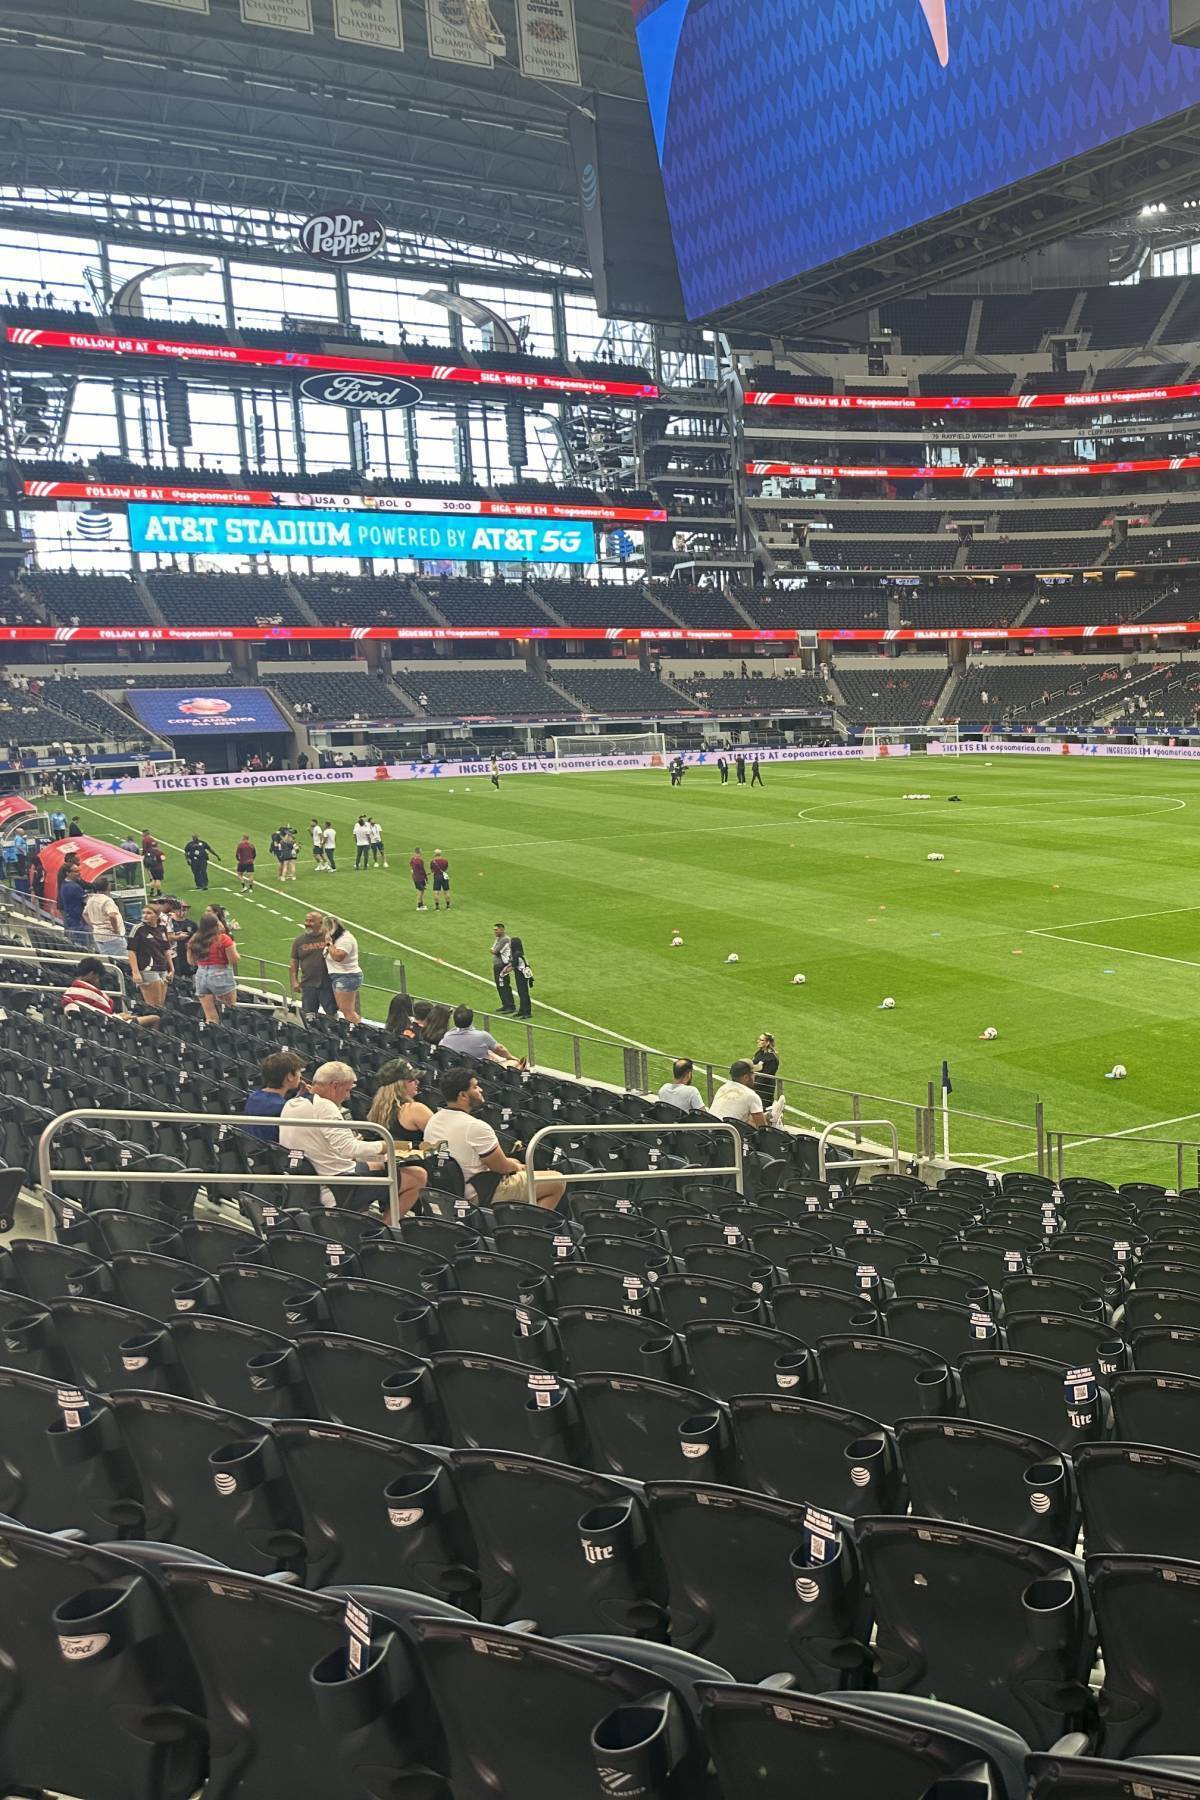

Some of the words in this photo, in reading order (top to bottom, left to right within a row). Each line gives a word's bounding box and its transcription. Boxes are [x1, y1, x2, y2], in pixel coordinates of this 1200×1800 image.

[350, 8, 386, 23] WORLD
[340, 16, 397, 35] CHAMPIONS
[358, 31, 381, 42] 1992
[534, 48, 565, 60] WORLD
[525, 55, 576, 72] CHAMPIONS
[334, 215, 364, 236] Dr
[304, 216, 381, 257] Pepper
[69, 335, 114, 349] FOLLOW
[118, 341, 132, 350] US
[136, 342, 148, 352] AT
[156, 344, 237, 359] @copaamerica
[324, 375, 400, 406] Ford
[86, 486, 131, 498] FOLLOW
[134, 488, 147, 499] US
[151, 489, 164, 500] AT
[172, 491, 251, 502] @copaamerica
[315, 496, 336, 505] USA
[342, 497, 350, 506] 0
[379, 499, 399, 508] BOL
[404, 500, 412, 508] 0
[443, 502, 472, 511] 30:00
[144, 515, 216, 543] AT&T
[225, 517, 352, 546] STADIUM
[357, 524, 441, 547] POWERED
[447, 529, 467, 548] BY
[471, 527, 538, 551] AT&T
[540, 528, 582, 552] 5G
[769, 751, 779, 760] AT
[782, 749, 864, 761] copaamerica.com
[990, 744, 1051, 753] copaamerica.com
[1106, 746, 1138, 755] INGRESSOS
[458, 762, 518, 775] INGRESOS
[522, 761, 537, 771] EM
[153, 777, 208, 790] TICKETS
[213, 776, 230, 786] EN
[234, 771, 353, 786] copaamerica.com
[1099, 1362, 1117, 1375] Lite
[1071, 1412, 1092, 1428] Lite
[390, 1509, 413, 1525] Ford
[582, 1541, 614, 1564] Lite
